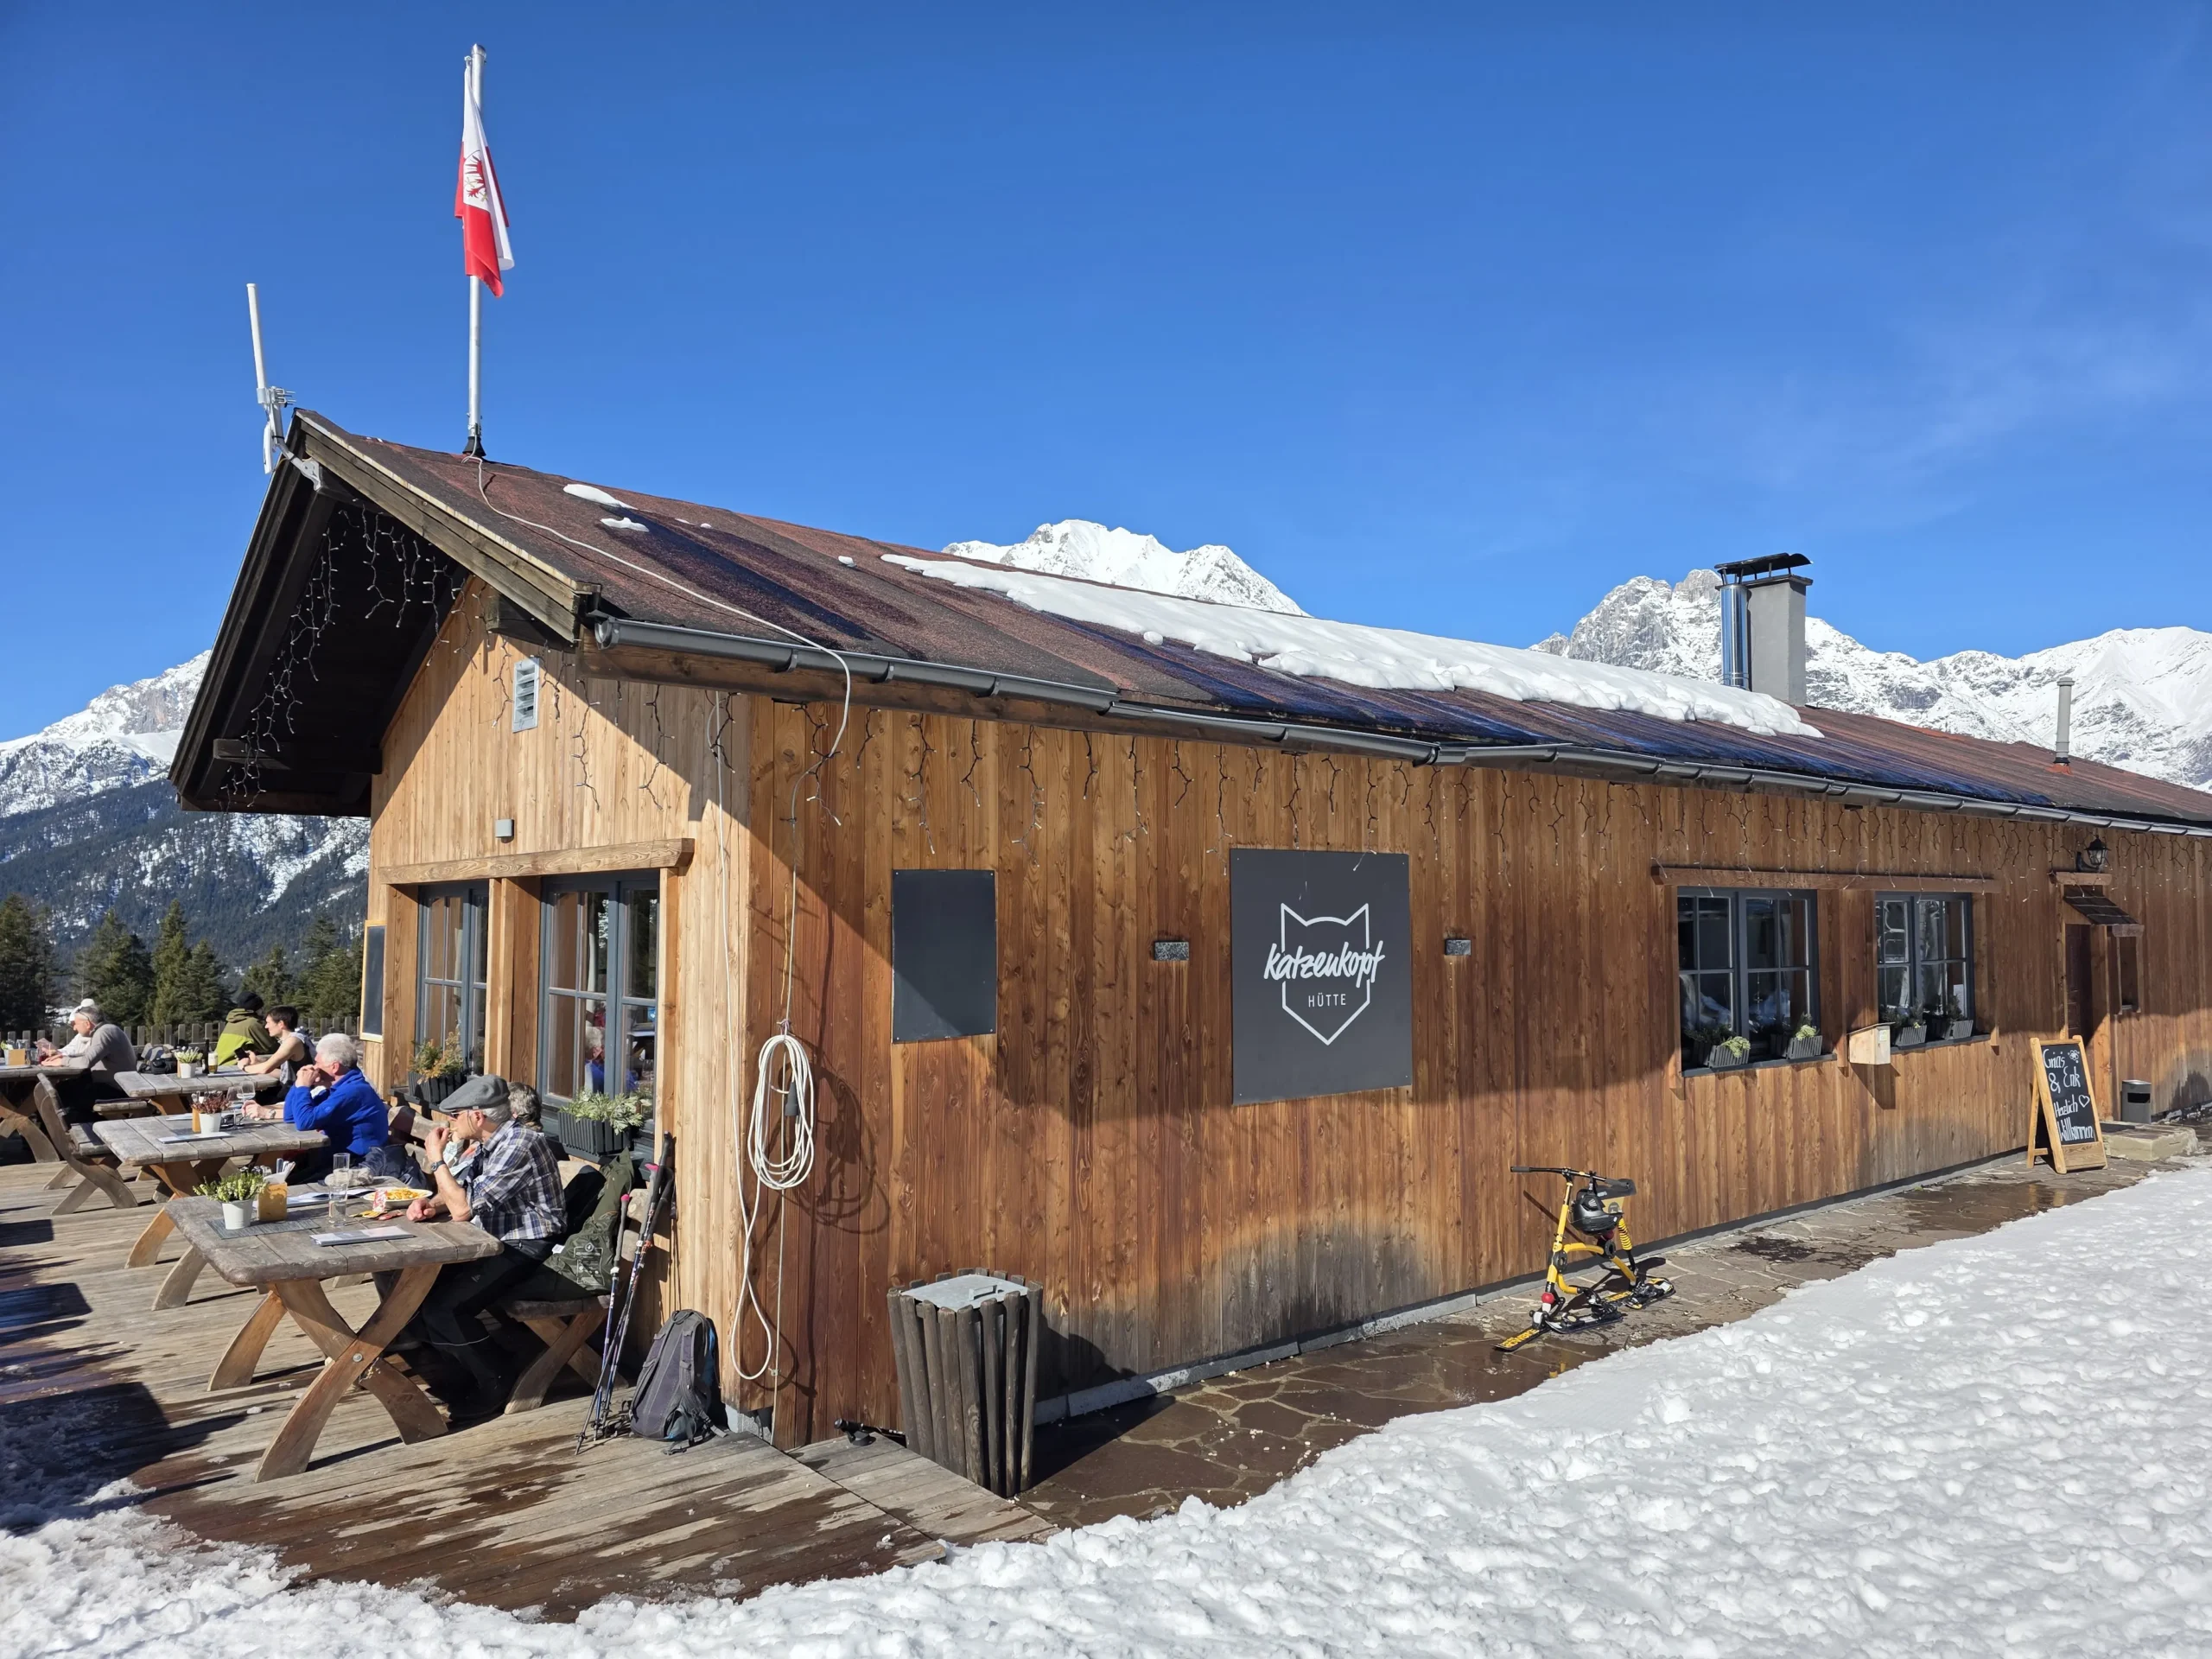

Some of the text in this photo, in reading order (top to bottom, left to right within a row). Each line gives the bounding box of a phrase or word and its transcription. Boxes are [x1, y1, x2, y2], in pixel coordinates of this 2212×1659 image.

[1308, 992, 1346, 1007] HÜTTE
[2048, 1065, 2081, 1094] & Enk
[2054, 1094, 2078, 1118] Herzlich
